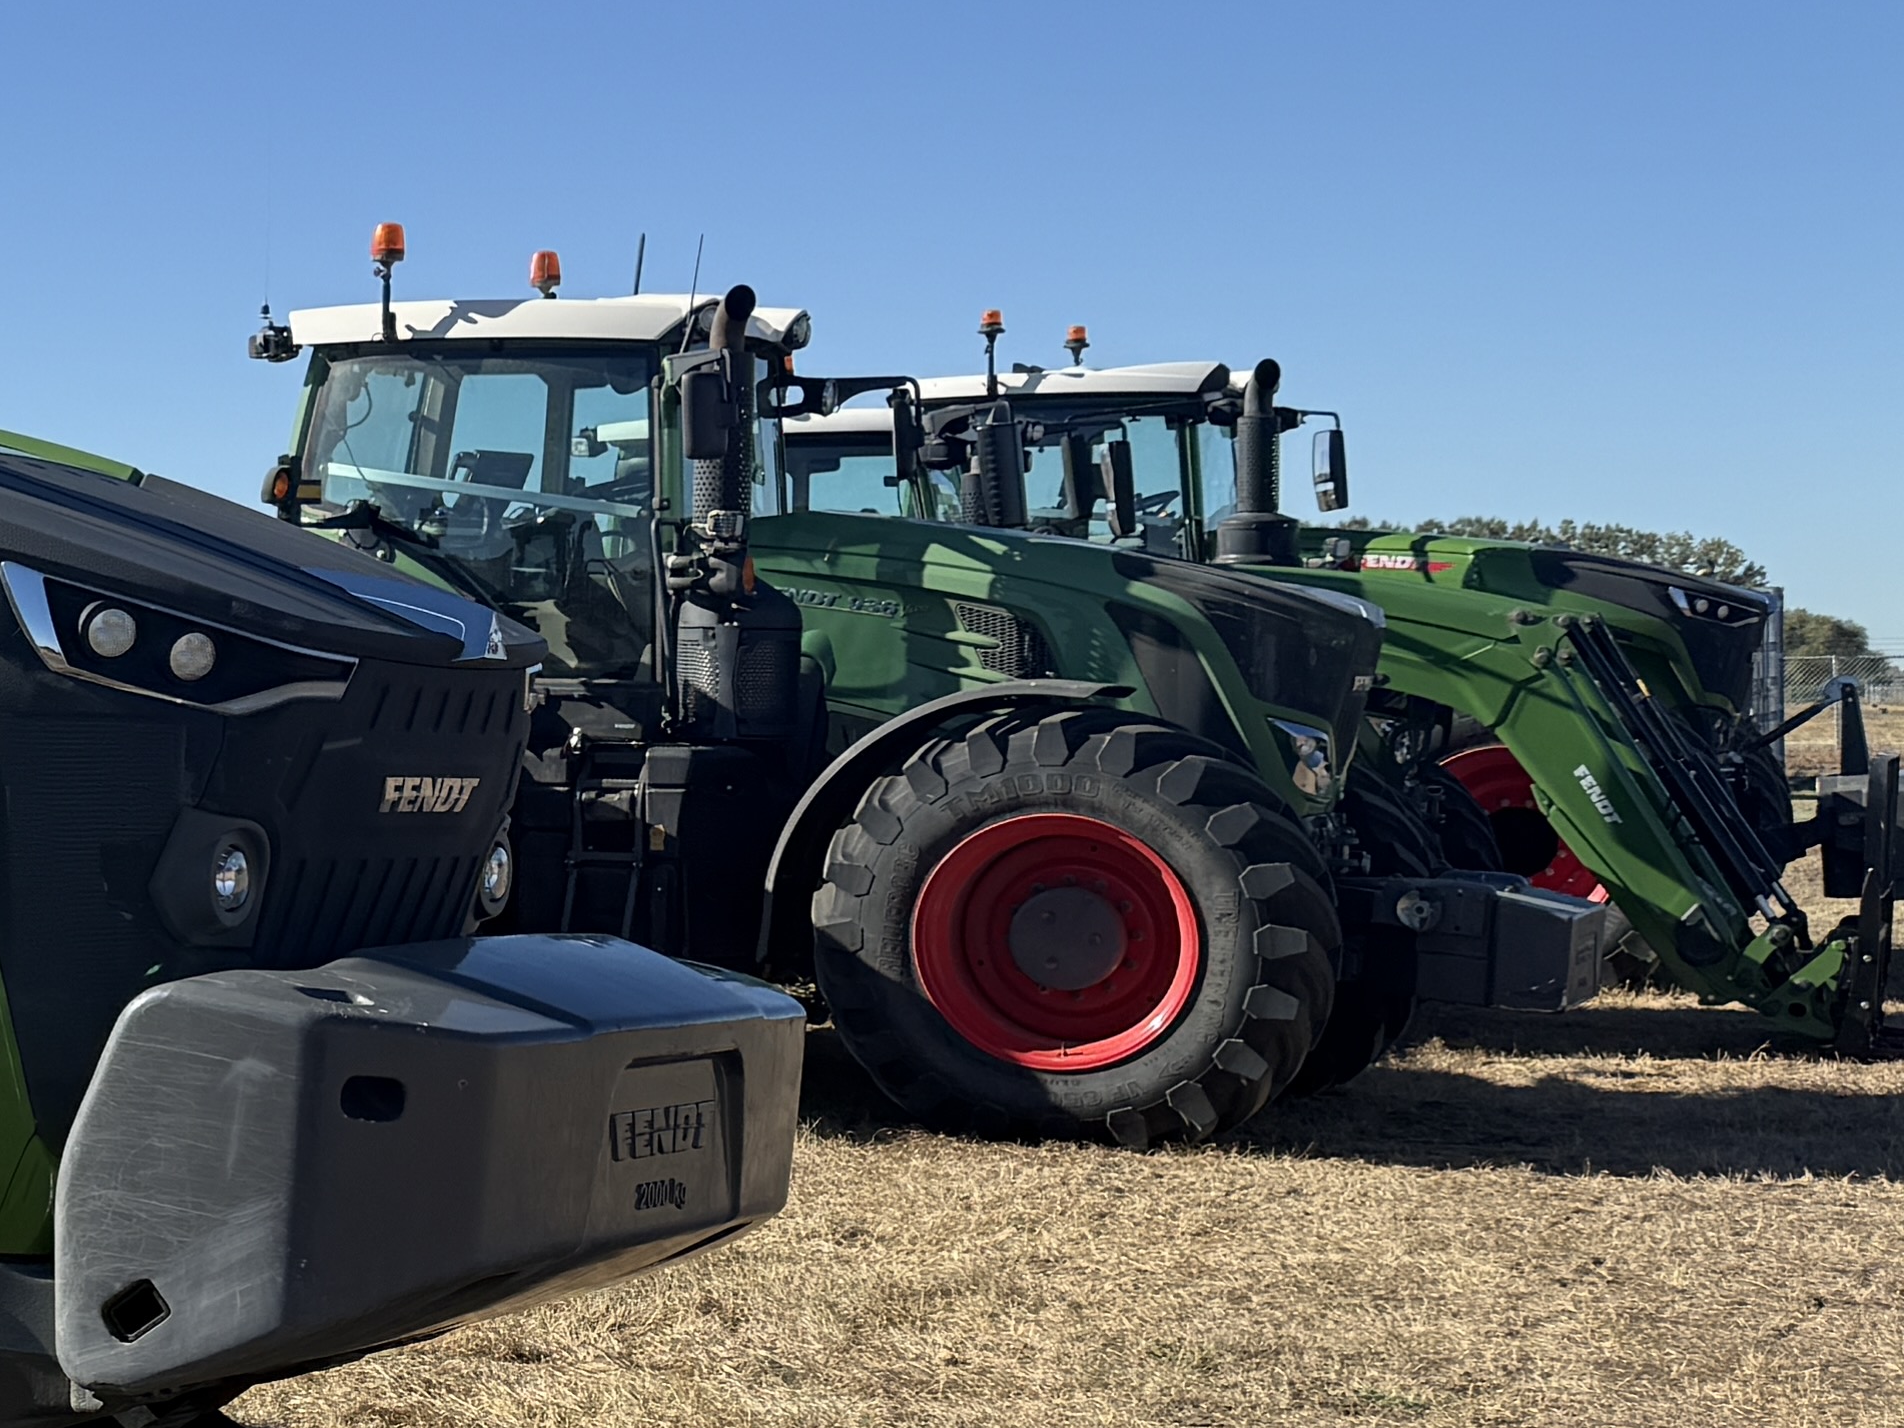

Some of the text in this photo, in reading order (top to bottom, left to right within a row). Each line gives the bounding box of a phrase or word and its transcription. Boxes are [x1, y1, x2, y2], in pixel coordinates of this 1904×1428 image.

[379, 776, 481, 813] FENDT
[1573, 763, 1623, 824] FENDT
[609, 1099, 716, 1162] FENDT
